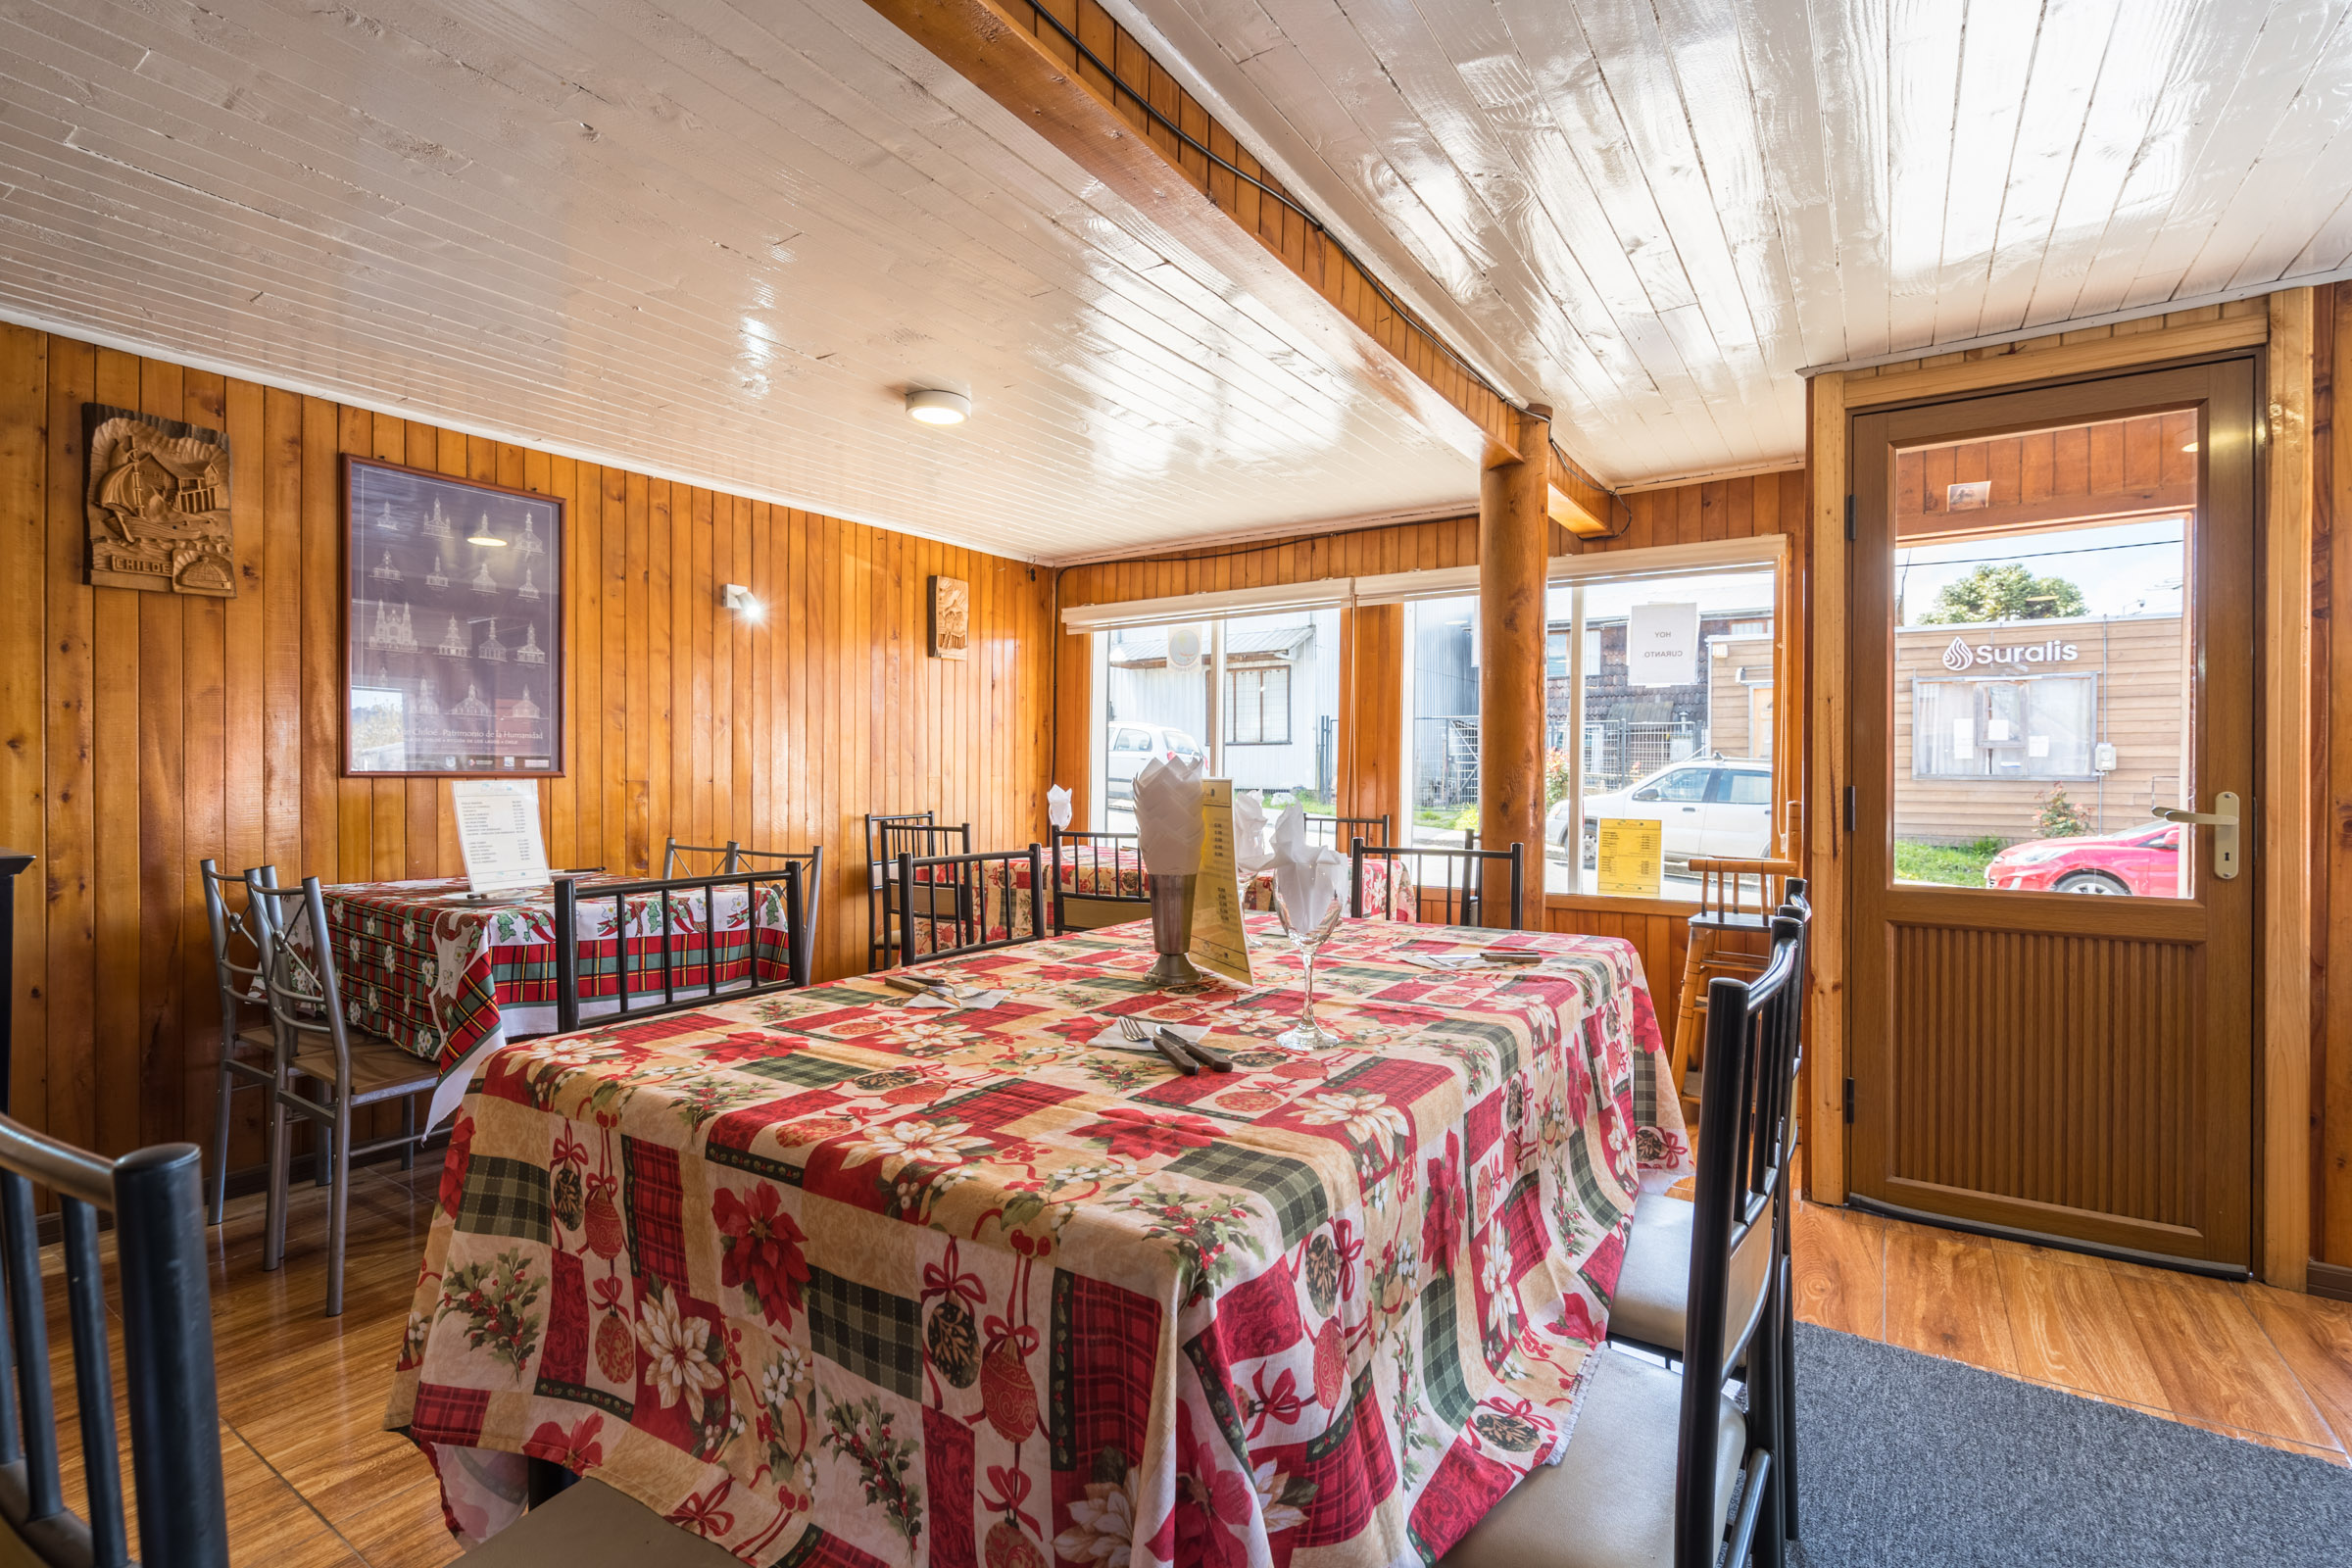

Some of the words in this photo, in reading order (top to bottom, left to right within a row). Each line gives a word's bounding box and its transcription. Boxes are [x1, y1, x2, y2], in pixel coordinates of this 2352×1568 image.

[117, 559, 171, 573] CHILOE
[1976, 640, 2079, 664] Suralis
[442, 728, 484, 738] Patrimonio
[485, 729, 495, 738] de
[504, 729, 543, 740] Humanidad
